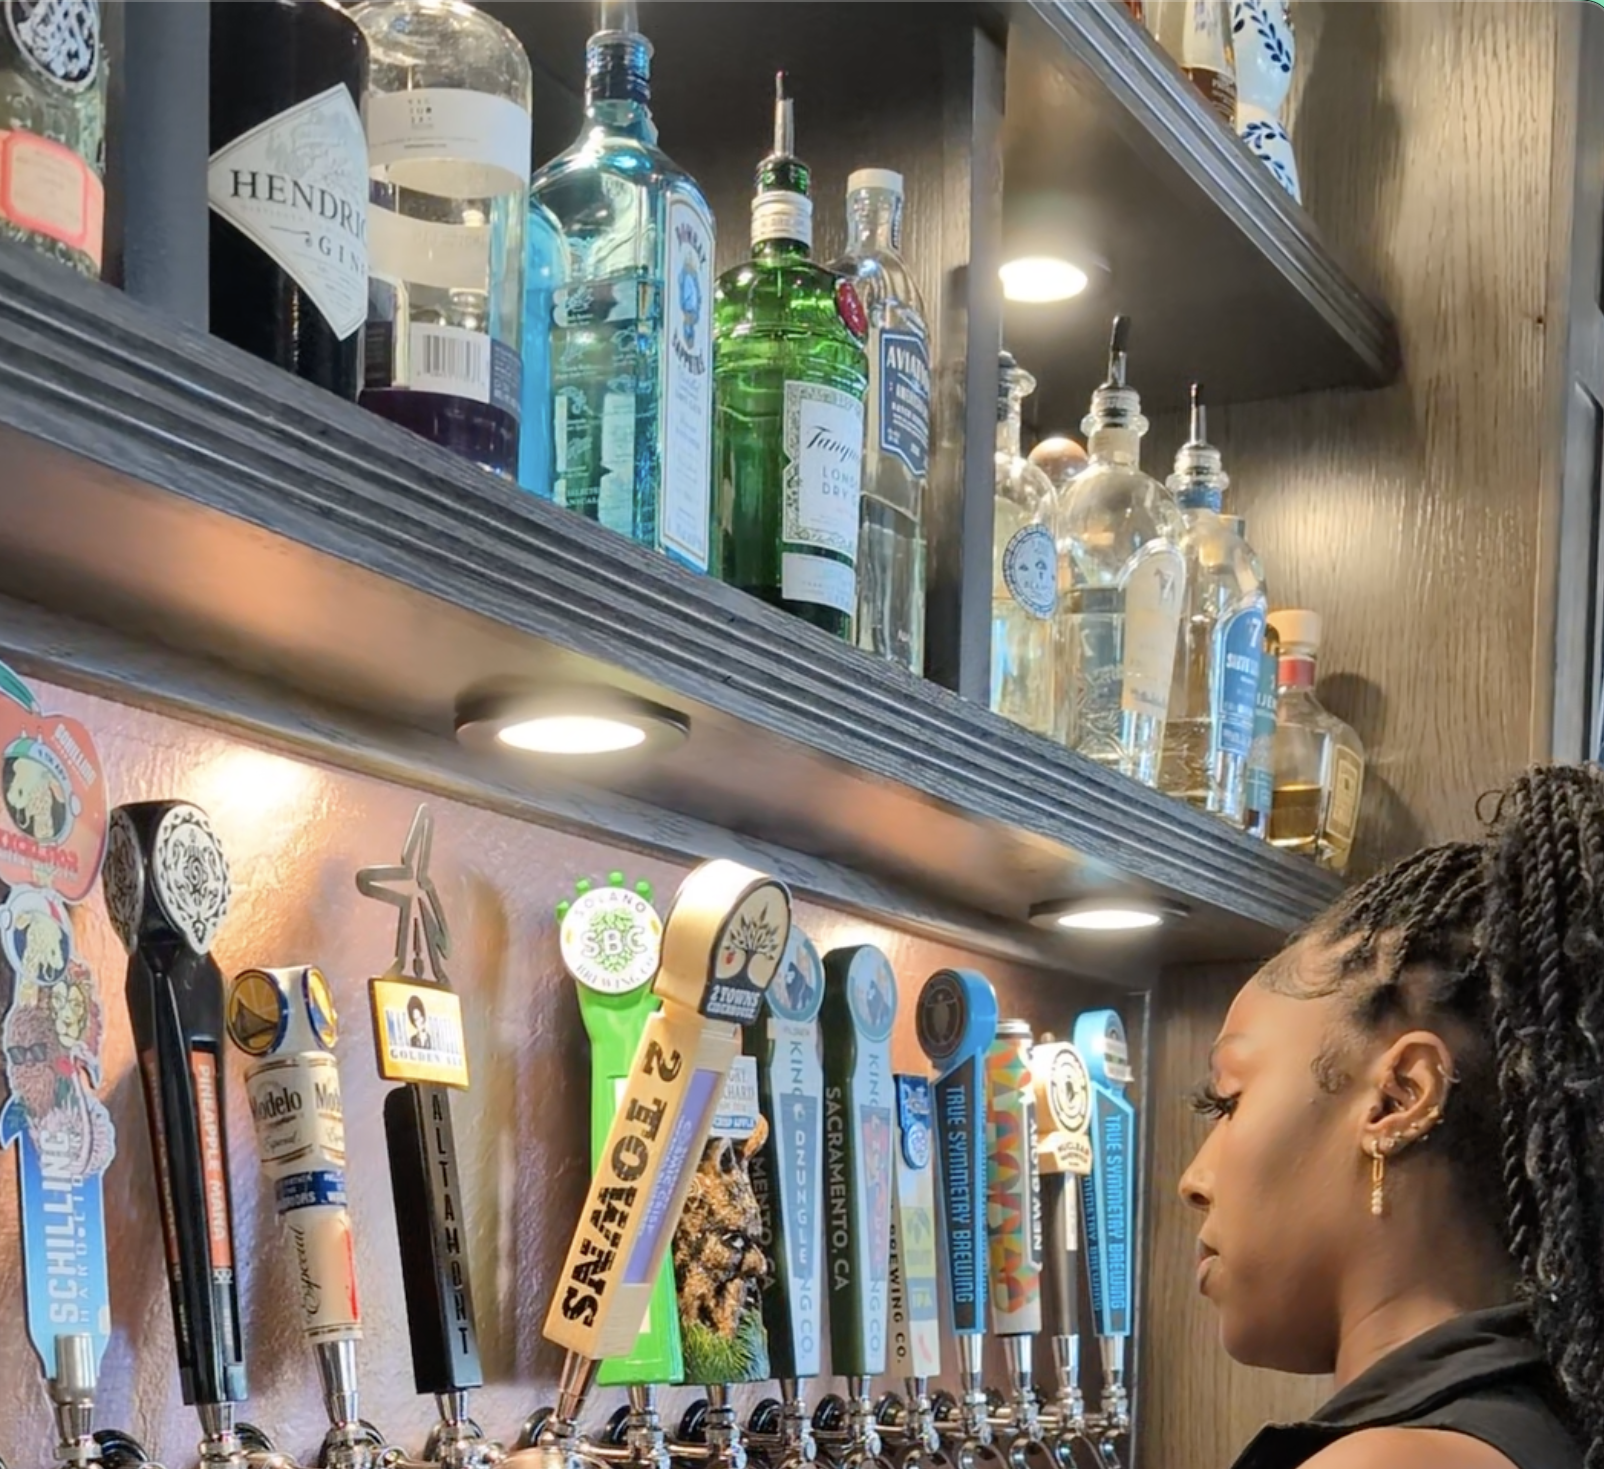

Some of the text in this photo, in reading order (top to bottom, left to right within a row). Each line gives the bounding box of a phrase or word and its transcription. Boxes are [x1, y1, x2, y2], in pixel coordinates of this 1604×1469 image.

[581, 925, 648, 958] SBC
[40, 1128, 79, 1324] SCHILLING
[562, 1040, 683, 1328] 2 TOWNS
[946, 1085, 974, 1304] TRUE SYMMETRY BREWING
[1032, 1201, 1043, 1251] NEW
[1105, 1115, 1125, 1309] TRUE SYMMETRY BREWING
[834, 1259, 849, 1291] CA
[895, 1332, 907, 1364] CO.
